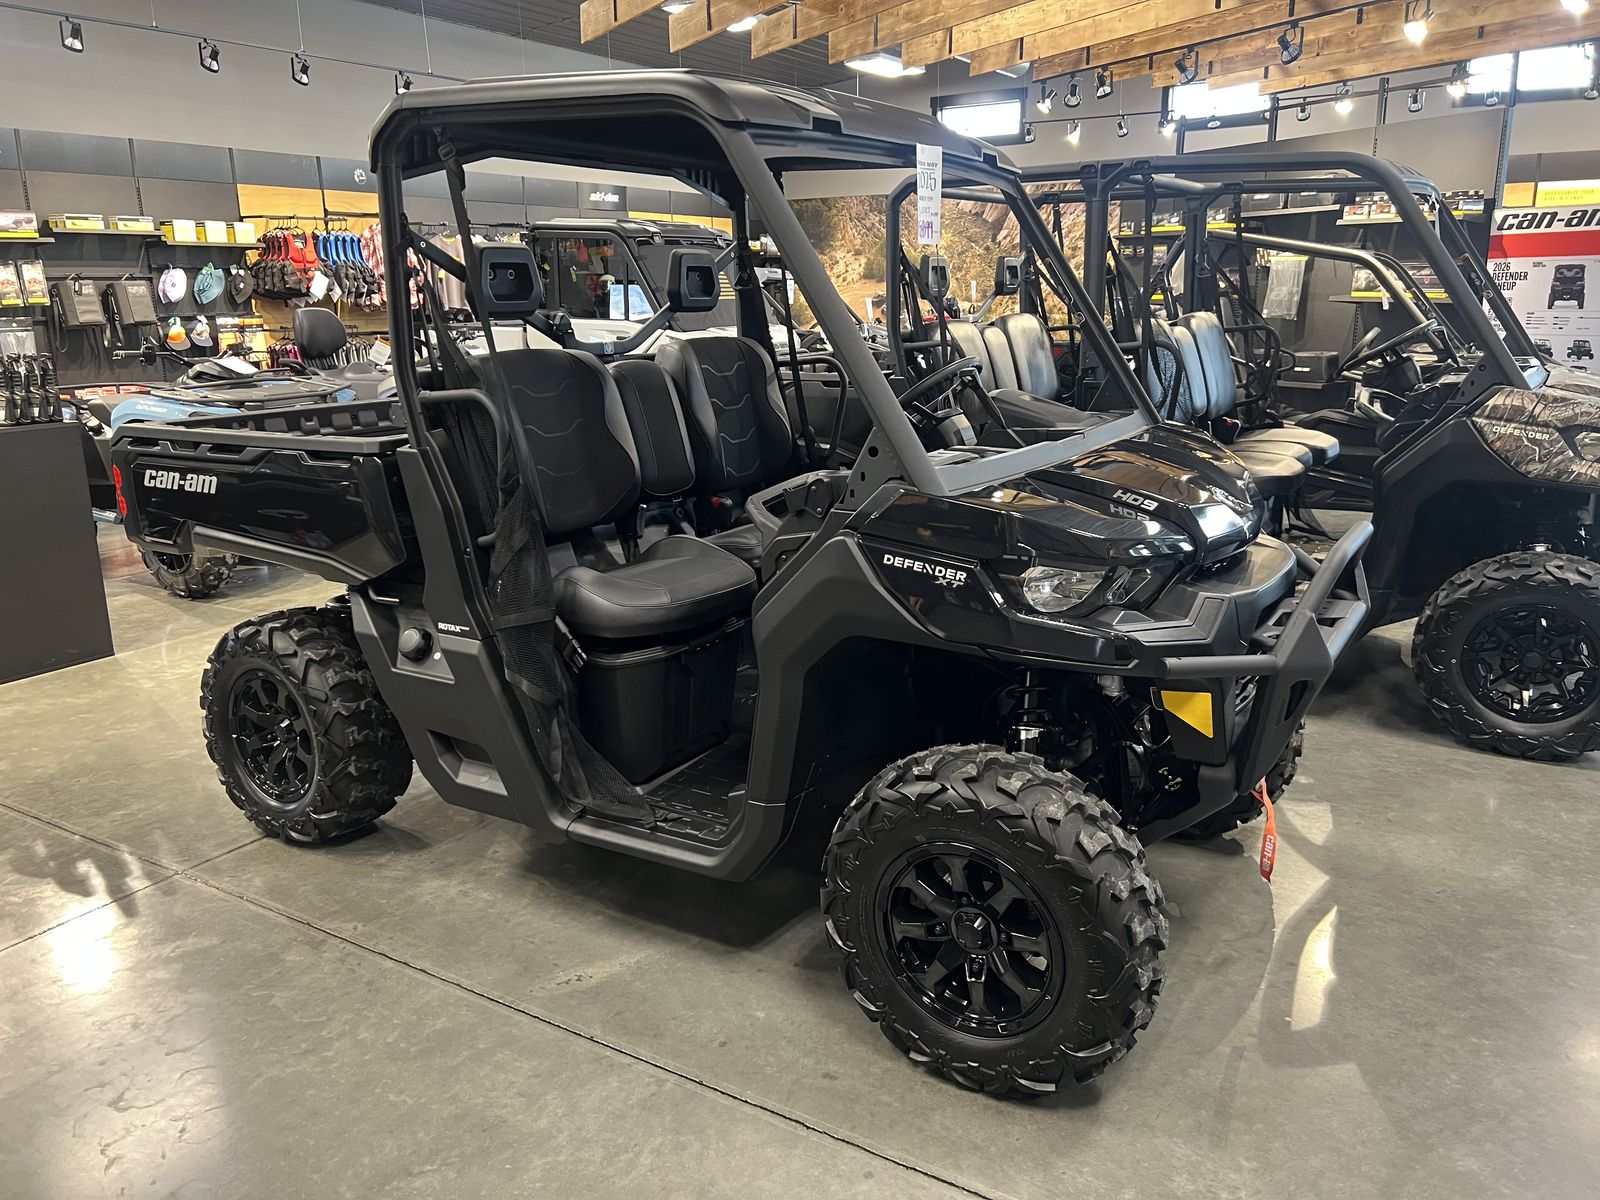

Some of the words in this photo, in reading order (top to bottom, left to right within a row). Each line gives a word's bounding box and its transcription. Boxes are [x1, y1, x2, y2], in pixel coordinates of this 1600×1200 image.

[1493, 261, 1512, 272] 2026
[1492, 271, 1529, 281] DEFENDER
[1495, 281, 1517, 291] NEUP
[1492, 426, 1550, 440] DEFENDER
[143, 469, 217, 494] can-am
[1112, 489, 1159, 511] HD9
[883, 554, 967, 581] DEFENDER
[934, 577, 965, 588] XT
[437, 622, 461, 633] ROTAX
